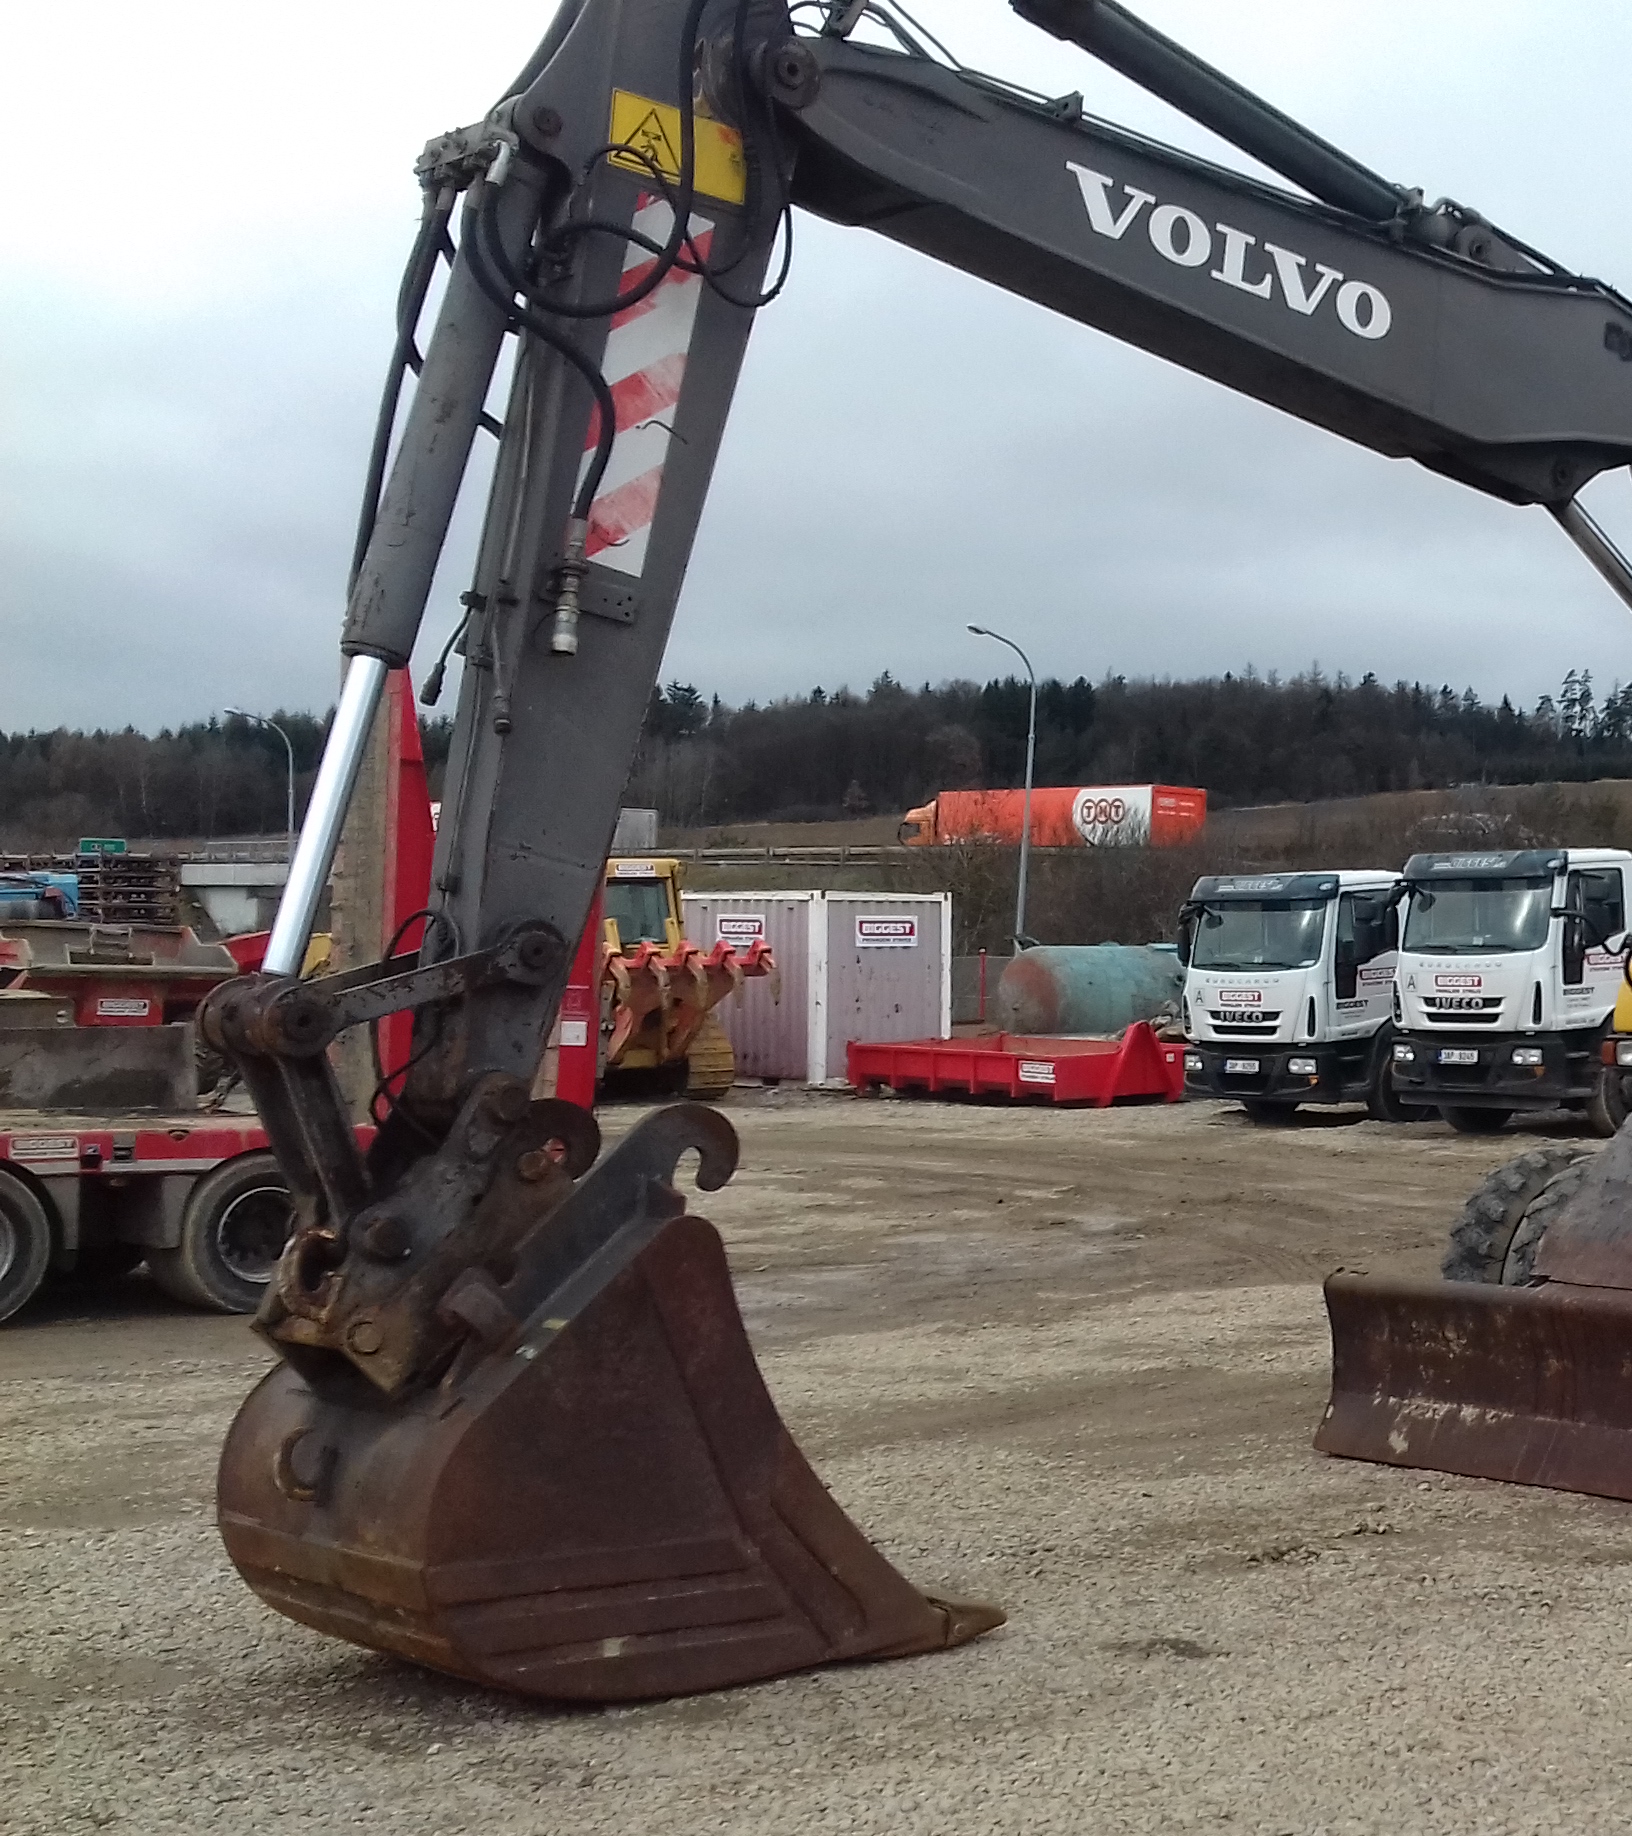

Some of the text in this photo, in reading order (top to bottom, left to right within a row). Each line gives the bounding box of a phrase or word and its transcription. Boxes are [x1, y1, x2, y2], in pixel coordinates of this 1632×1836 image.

[1065, 160, 1393, 341] VOLVO
[861, 922, 912, 934] BIGGEST
[1407, 974, 1416, 990] A
[1437, 976, 1480, 986] BIGGEST
[1195, 990, 1204, 1004] A
[1435, 997, 1485, 1010] IVECO
[1220, 1010, 1264, 1023] IVECO
